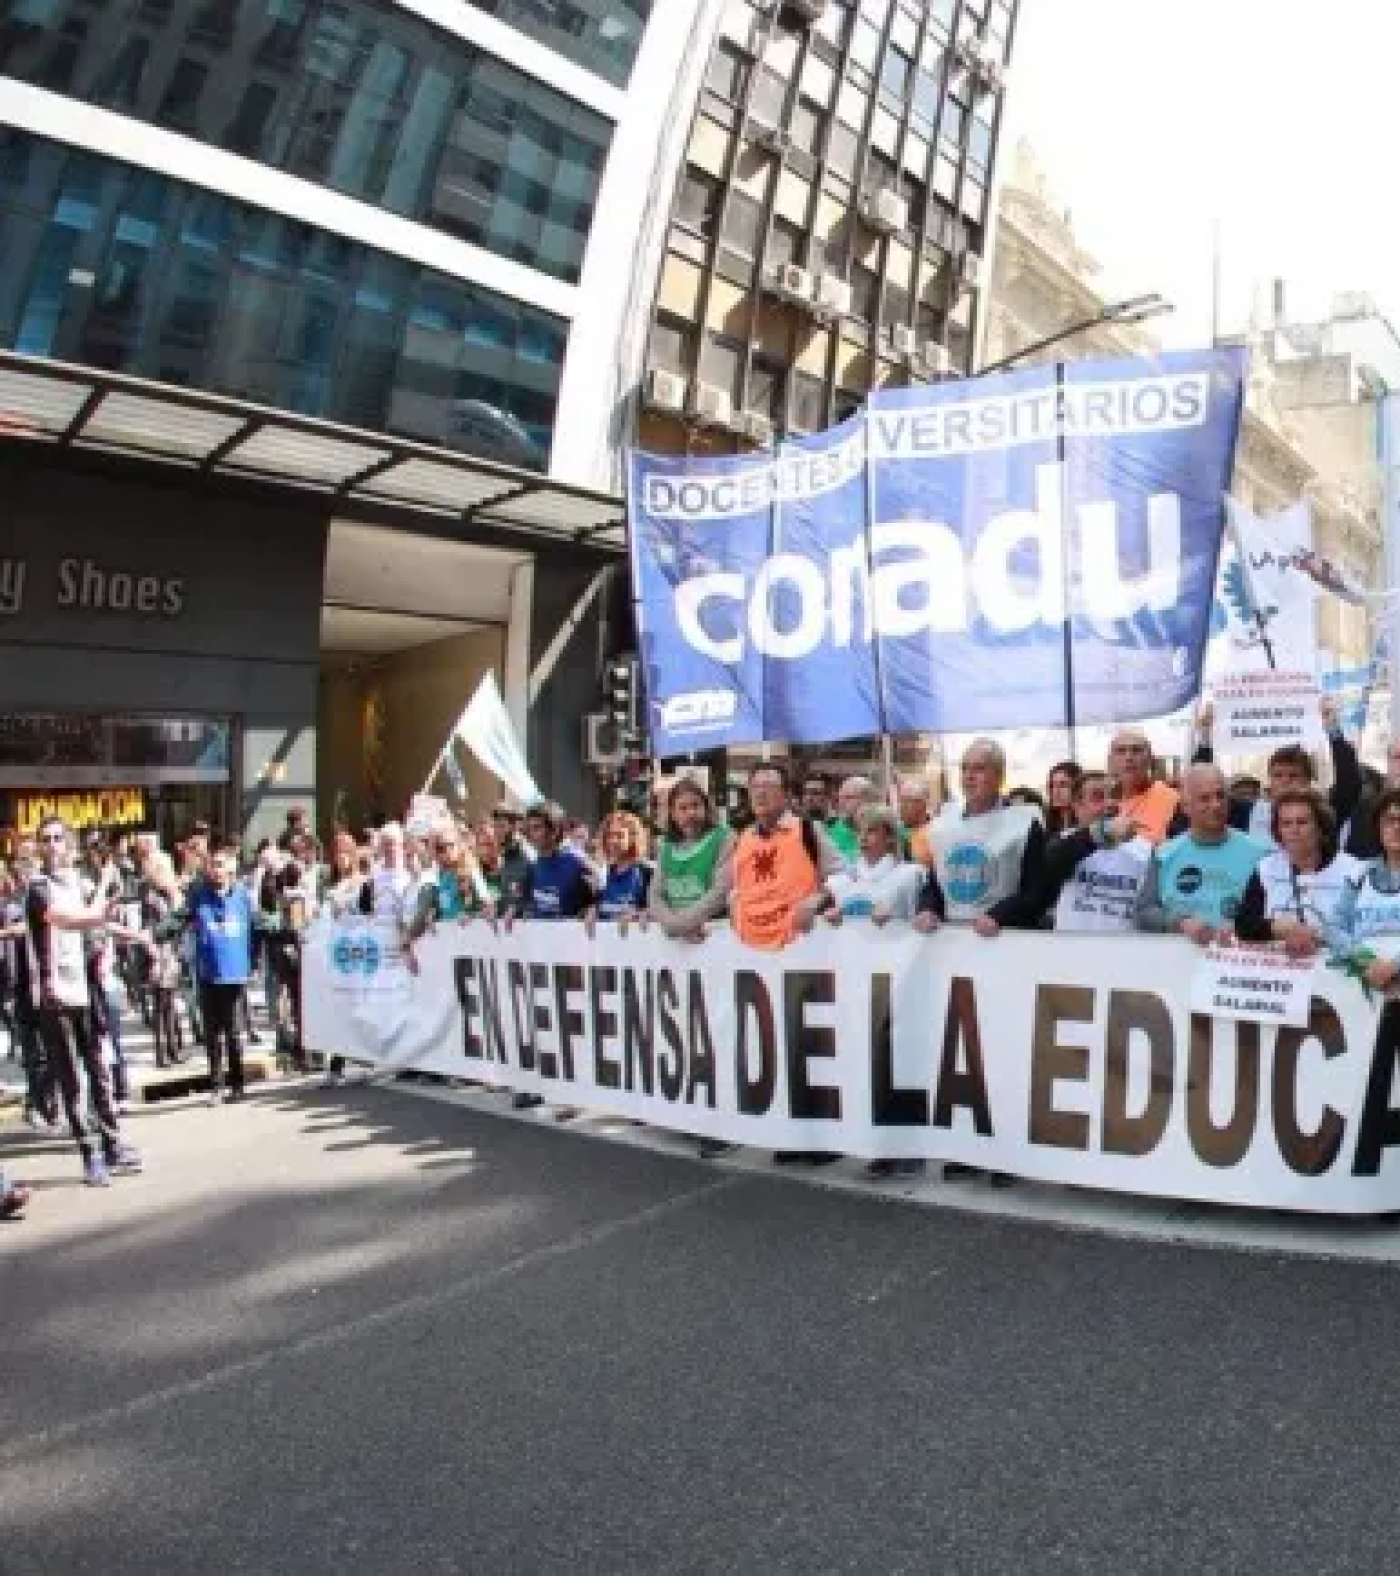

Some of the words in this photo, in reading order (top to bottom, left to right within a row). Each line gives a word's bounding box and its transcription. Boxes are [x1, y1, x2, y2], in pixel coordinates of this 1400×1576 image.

[877, 378, 1204, 450] VERSITARIOS
[57, 557, 183, 614] Shoes
[673, 461, 1182, 664] conadu
[1213, 994, 1287, 1015] SALARIAL
[1216, 975, 1294, 995] AUMENTO
[453, 956, 508, 1065] EN
[507, 958, 717, 1109] DEFENSA
[734, 970, 843, 1121] DE
[869, 971, 995, 1136] LA
